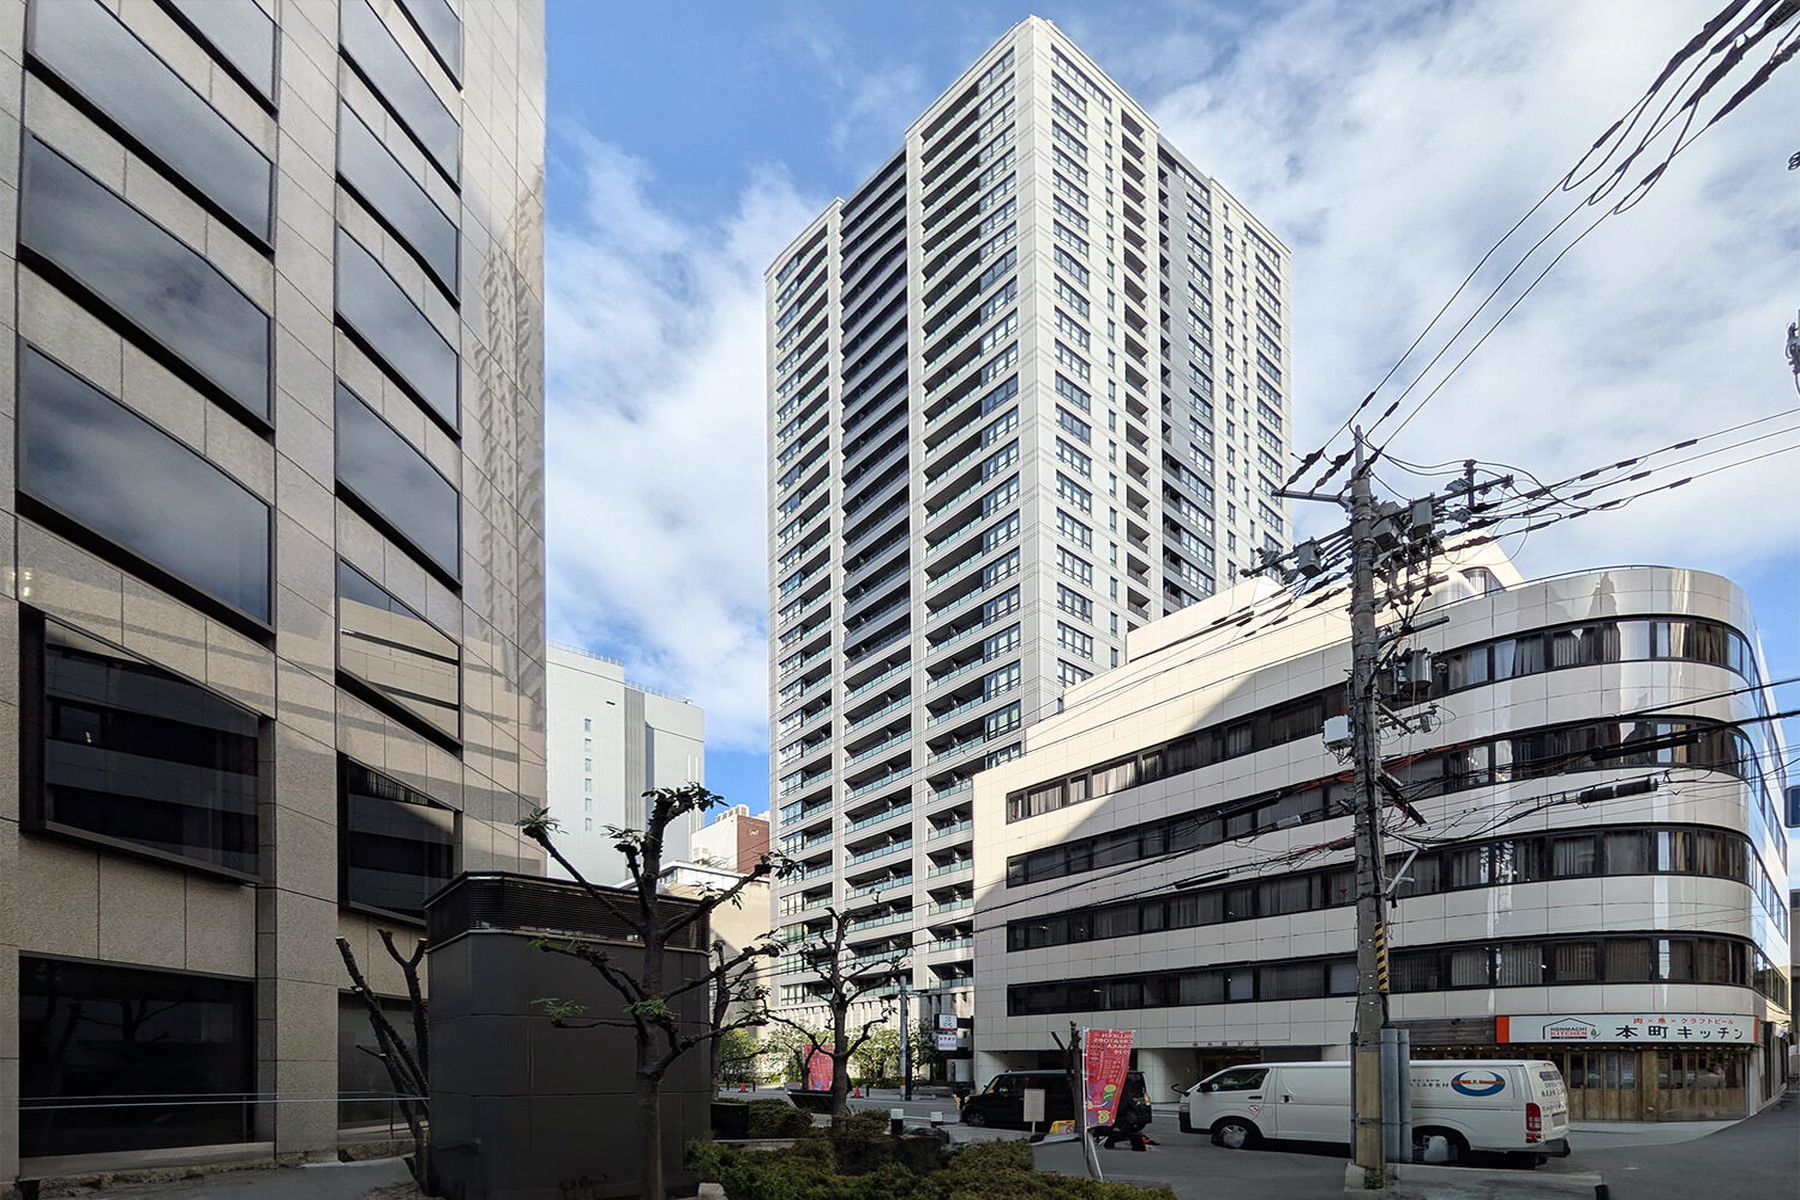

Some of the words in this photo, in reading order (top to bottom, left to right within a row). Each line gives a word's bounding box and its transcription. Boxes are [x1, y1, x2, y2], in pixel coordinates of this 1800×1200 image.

[1615, 1024, 1743, 1039] 本町キッチン
